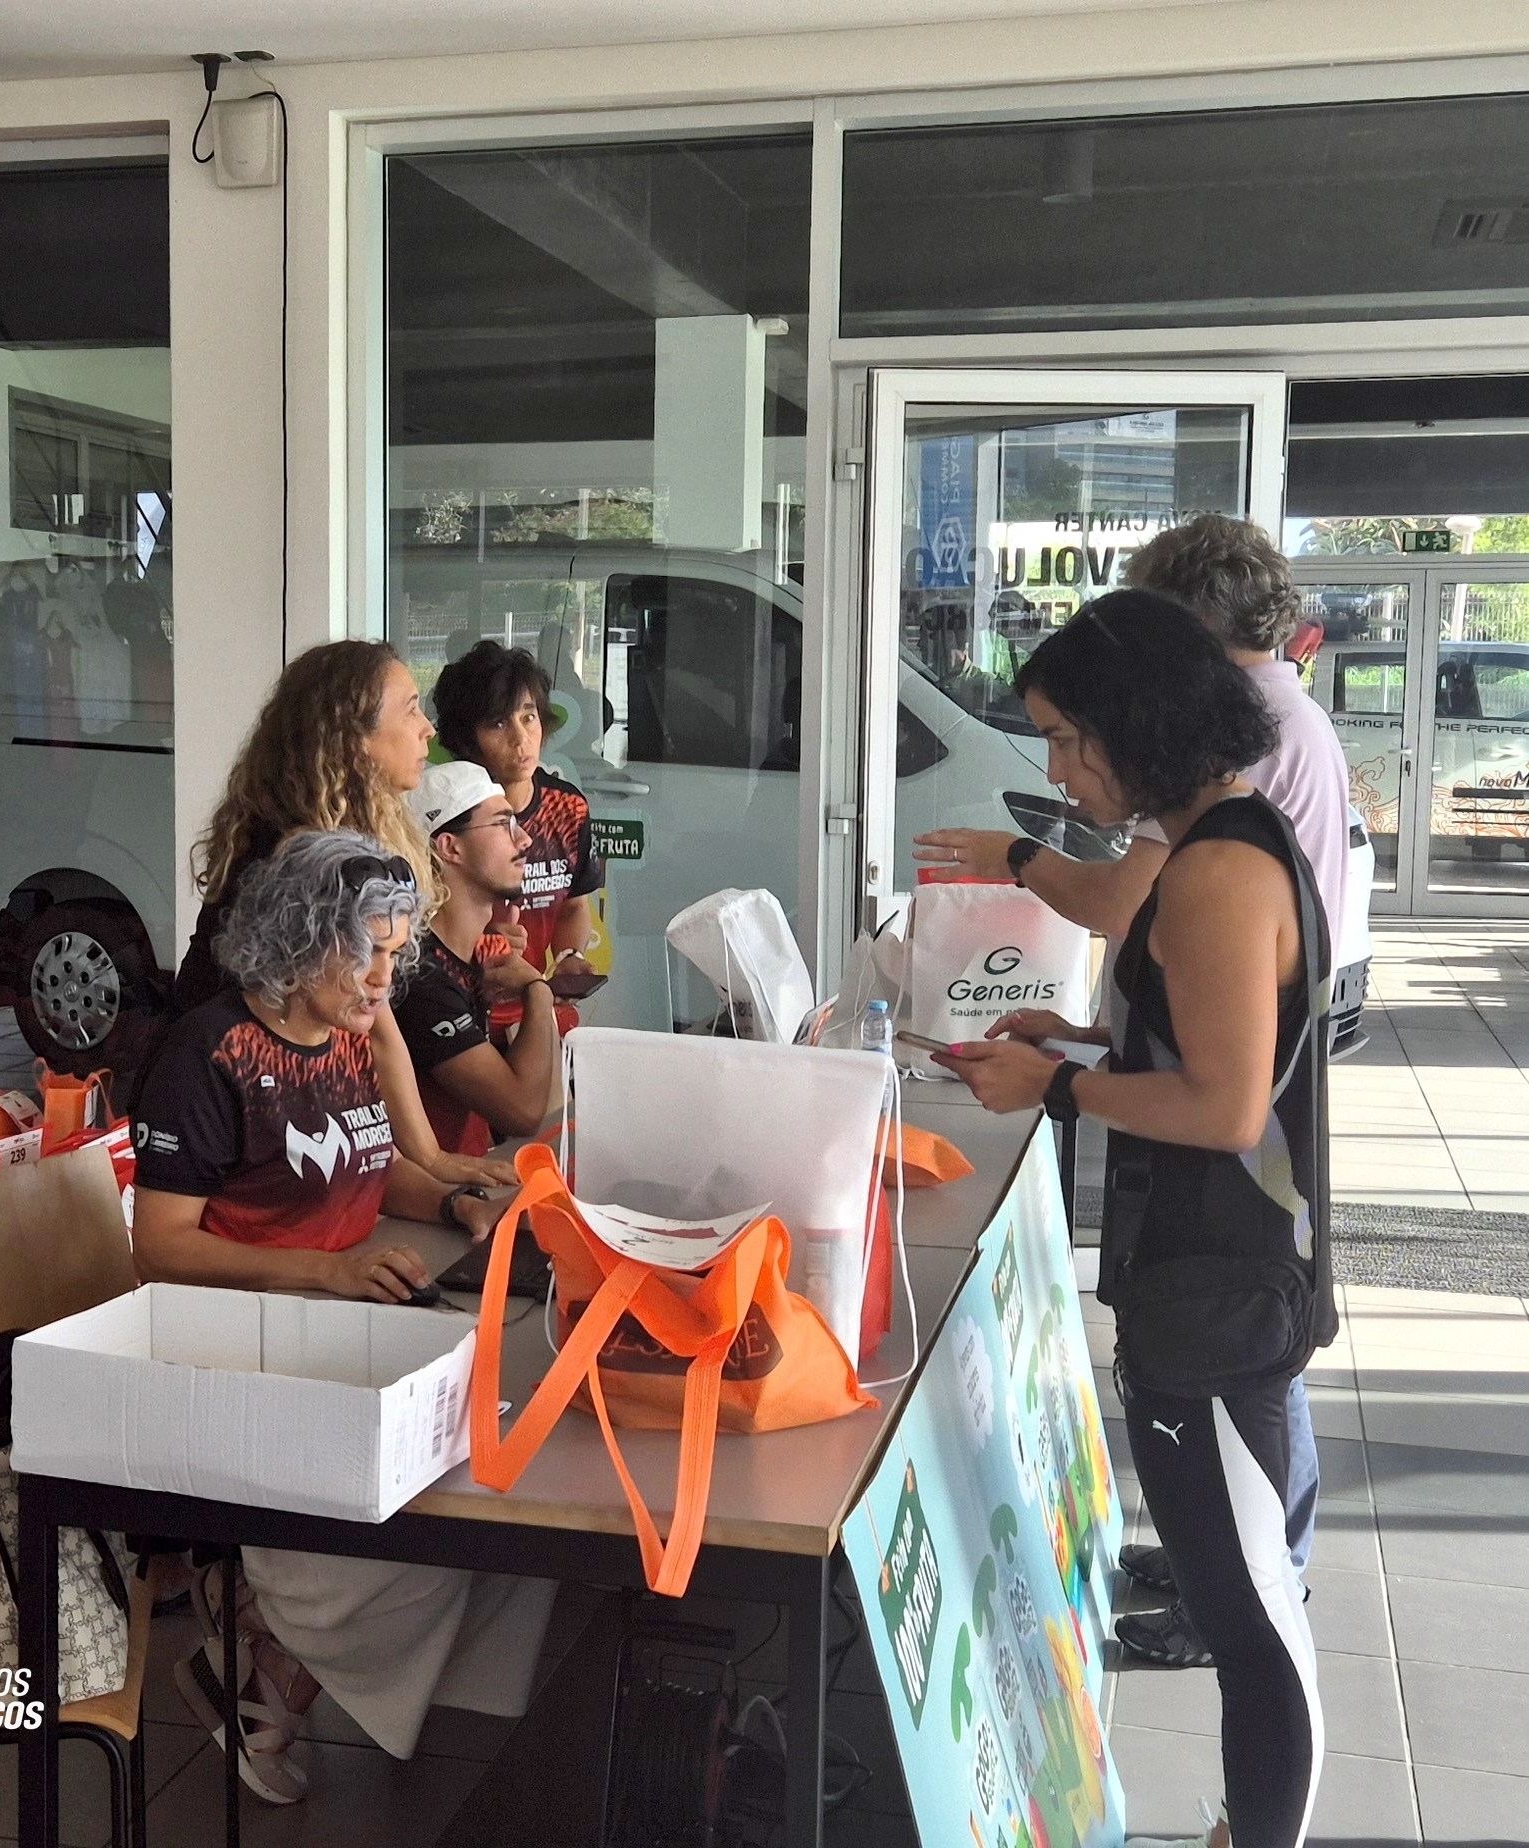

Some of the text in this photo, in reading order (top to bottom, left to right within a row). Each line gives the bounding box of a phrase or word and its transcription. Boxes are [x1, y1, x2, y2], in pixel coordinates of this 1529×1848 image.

[1331, 718, 1384, 728] OKING
[590, 822, 624, 834] eito com
[600, 838, 639, 856] FRUTA
[947, 979, 1057, 1001] Generis
[950, 1007, 983, 1017] Saúde
[986, 1009, 1003, 1017] em
[341, 1100, 389, 1131] TRAIL DO
[10, 1148, 26, 1165] 239
